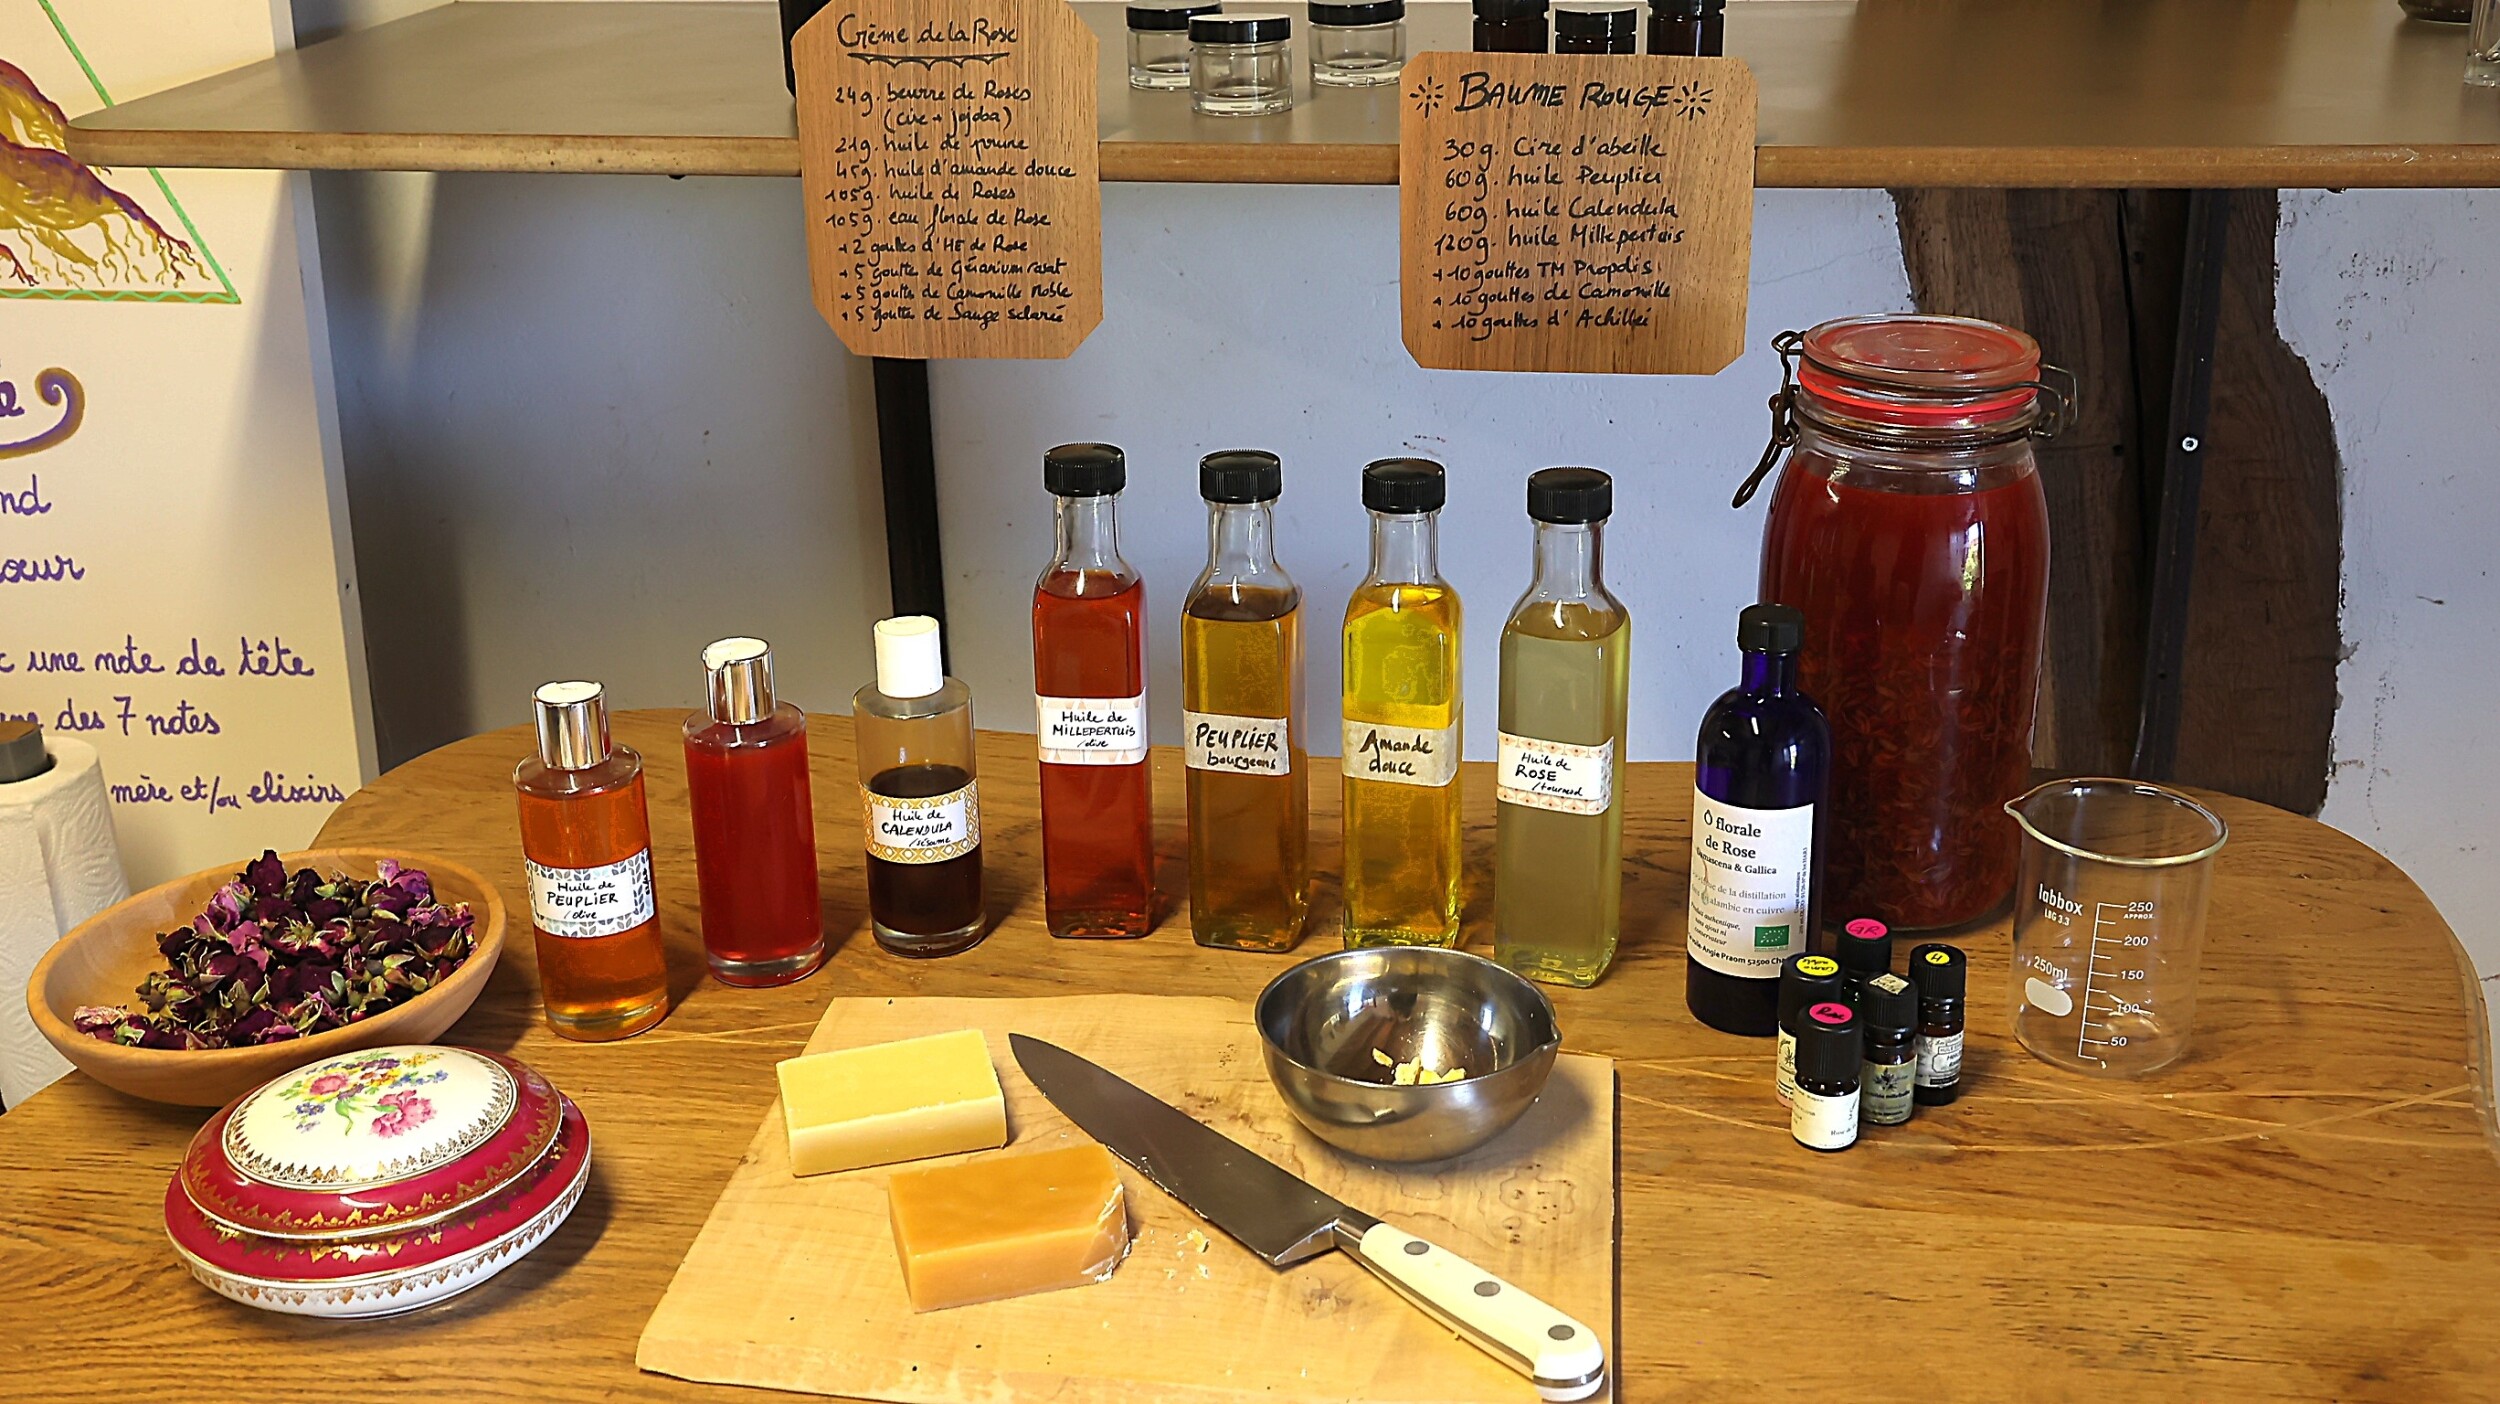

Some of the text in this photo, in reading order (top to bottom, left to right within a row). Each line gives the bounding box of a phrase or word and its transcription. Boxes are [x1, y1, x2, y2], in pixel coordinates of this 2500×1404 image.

[917, 20, 946, 44] de
[950, 20, 970, 44] la
[971, 16, 1018, 46] Rose
[886, 82, 946, 102] beurre
[952, 82, 976, 100] de
[984, 80, 1032, 102] Roses
[1454, 70, 1676, 118] BAUME ROUGE
[884, 104, 1012, 138] (cire + jojoba)
[883, 132, 930, 152] huile
[940, 132, 960, 150] de
[969, 136, 1028, 161] prune
[1513, 136, 1562, 158] Cire
[1571, 134, 1668, 158] d'abeille
[884, 160, 924, 178] huile
[930, 158, 1018, 178] d'amande
[1024, 160, 1076, 178] douce
[890, 182, 934, 200] huile
[941, 182, 960, 200] de
[972, 180, 1016, 200] Roses
[1508, 164, 1564, 186] huile
[1576, 166, 1662, 196] Peuplier
[1506, 196, 1560, 218] huile
[1568, 196, 1679, 218] Calendula
[888, 210, 919, 224] eau
[925, 204, 980, 236] florale
[986, 210, 1006, 226] de
[1014, 208, 1051, 227] Rose
[970, 237, 986, 251] de
[992, 233, 1028, 252] Rose
[1508, 224, 1560, 248] huile
[926, 260, 943, 277] de
[950, 256, 1023, 283] Géranium
[1466, 260, 1530, 294] gouttes
[1536, 261, 1564, 278] TM
[1573, 254, 1653, 284] Propolis
[922, 282, 940, 298] de
[1468, 286, 1534, 316] gouttes
[1543, 282, 1571, 300] de
[924, 304, 942, 320] de
[948, 302, 1000, 330] Sauge
[1471, 311, 1538, 341] gouttes
[26, 650, 85, 673] une
[94, 634, 166, 674] note
[176, 637, 226, 678] de
[238, 636, 315, 678] tête
[54, 698, 106, 732] des
[112, 696, 136, 736] 7
[146, 699, 222, 735] notes
[1062, 711, 1127, 722] Huile de
[1358, 728, 1433, 757] Amande
[1207, 751, 1276, 770] bourgeons
[1369, 758, 1416, 776] douce
[1522, 752, 1572, 771] Huile de
[1515, 764, 1556, 781] ROSE
[110, 774, 174, 803] mère
[893, 808, 945, 822] Huile de
[882, 822, 952, 836] CALENDULA
[1716, 817, 1761, 838] florale
[1706, 834, 1756, 858] de Rose
[1734, 864, 1742, 872] &
[1745, 865, 1776, 874] Gallica
[558, 880, 615, 892] Huile de
[1729, 888, 1736, 896] la
[1738, 890, 1786, 900] distillation
[2038, 883, 2084, 916] labbox
[2128, 902, 2154, 912] 250
[2058, 914, 2070, 926] 3.3
[2124, 936, 2149, 946] 200
[2033, 955, 2068, 980] 250ml
[2121, 970, 2144, 980] 150
[2116, 1003, 2140, 1013] 100
[2110, 1037, 2128, 1046] 50
